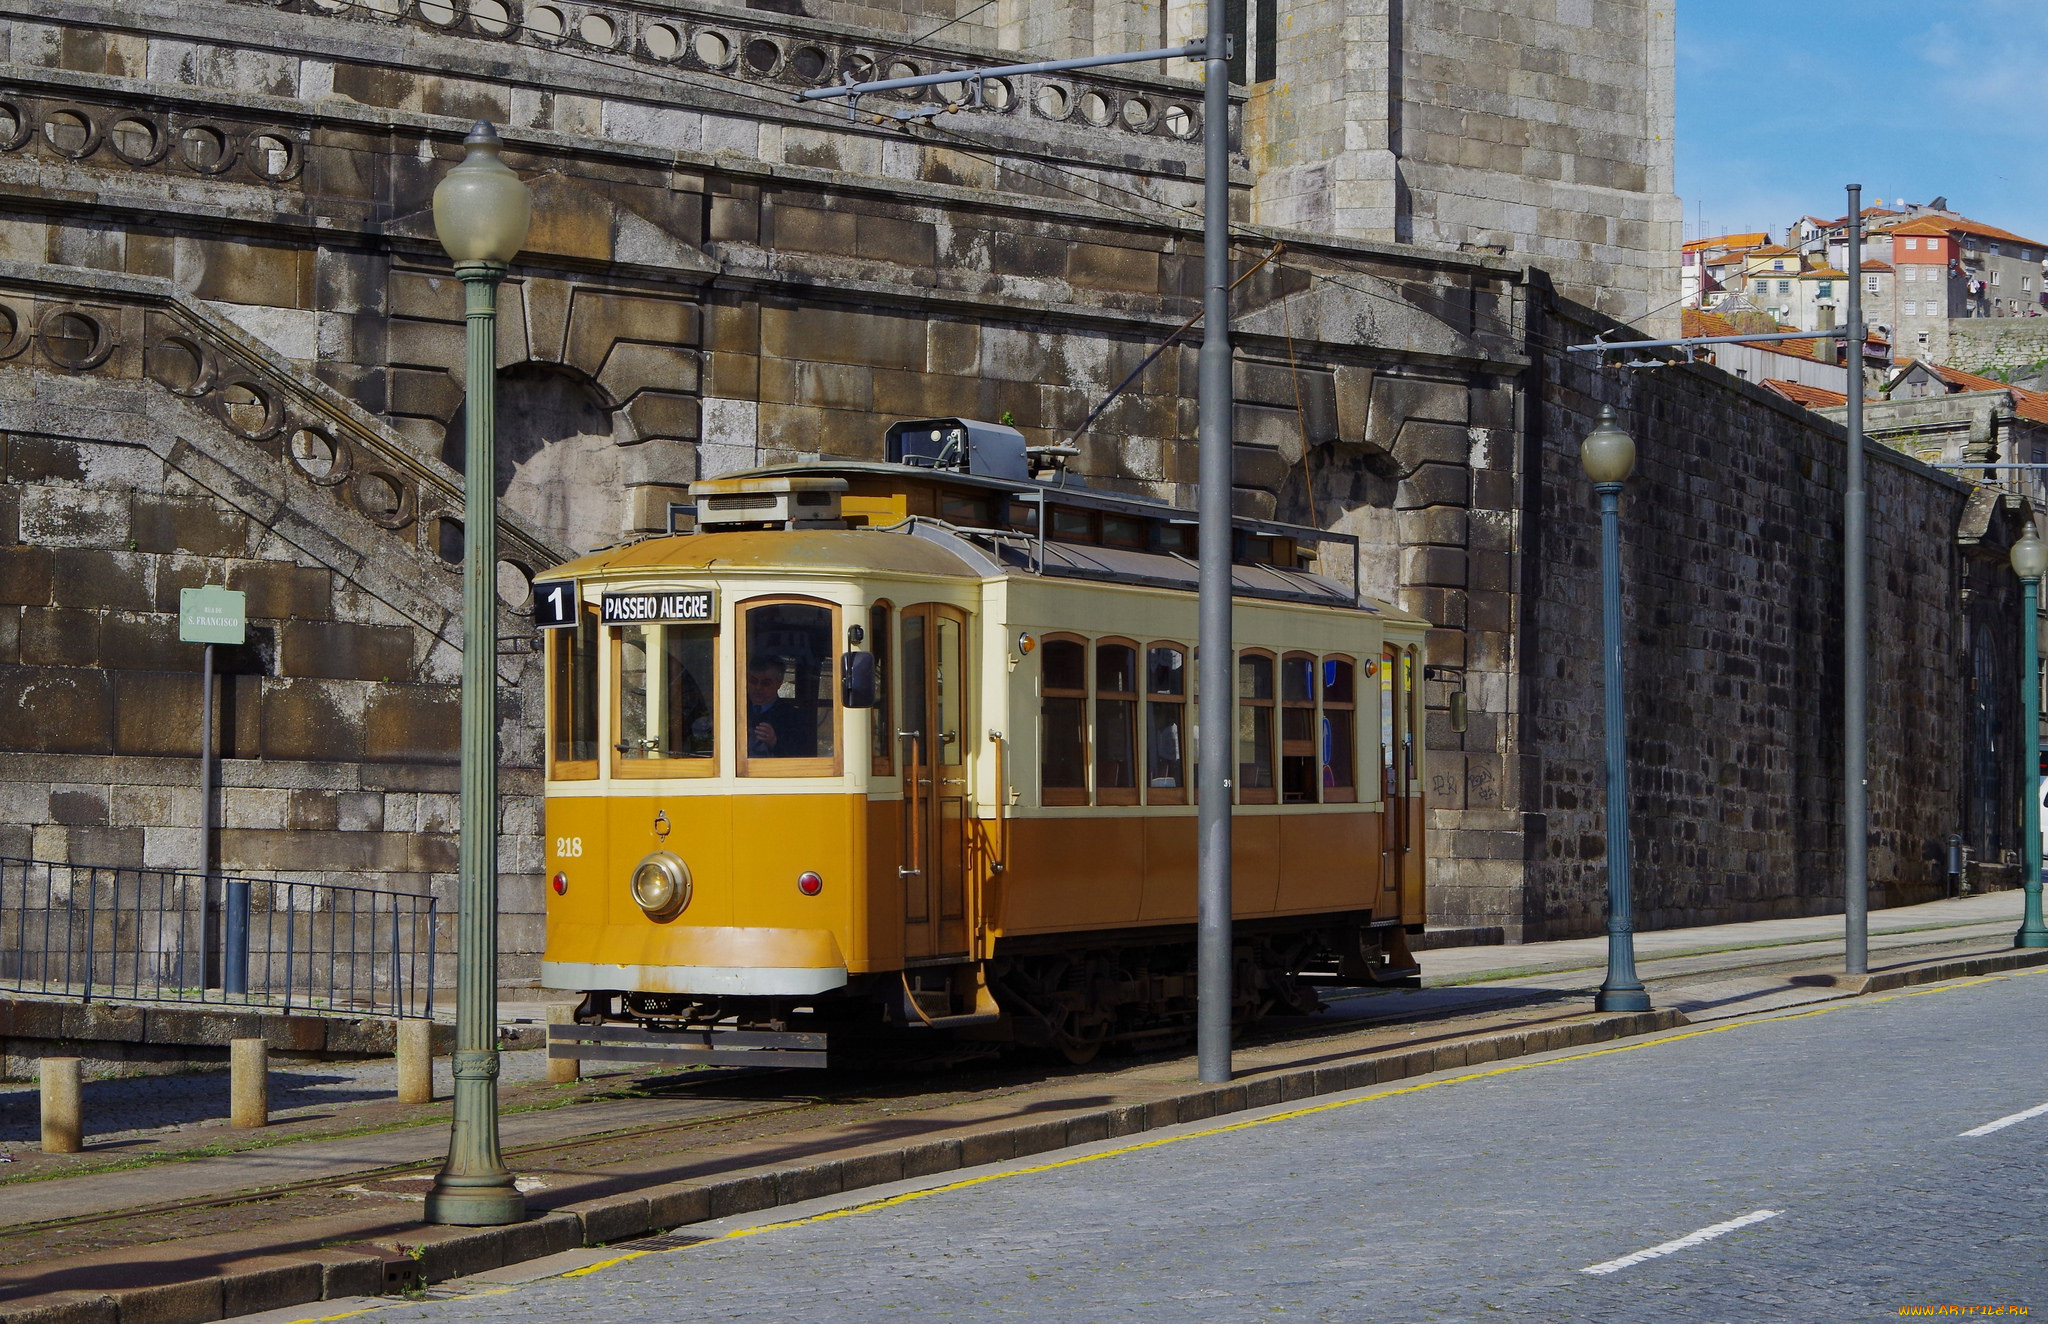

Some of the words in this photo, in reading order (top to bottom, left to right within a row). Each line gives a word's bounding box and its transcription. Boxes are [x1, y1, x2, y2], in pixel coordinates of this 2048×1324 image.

[547, 586, 563, 621] 1
[605, 596, 657, 620] PASSEIO
[660, 595, 708, 618] ALEGRE
[188, 615, 195, 625] S.
[196, 616, 238, 627] FRANCISCO
[556, 836, 583, 858] 218
